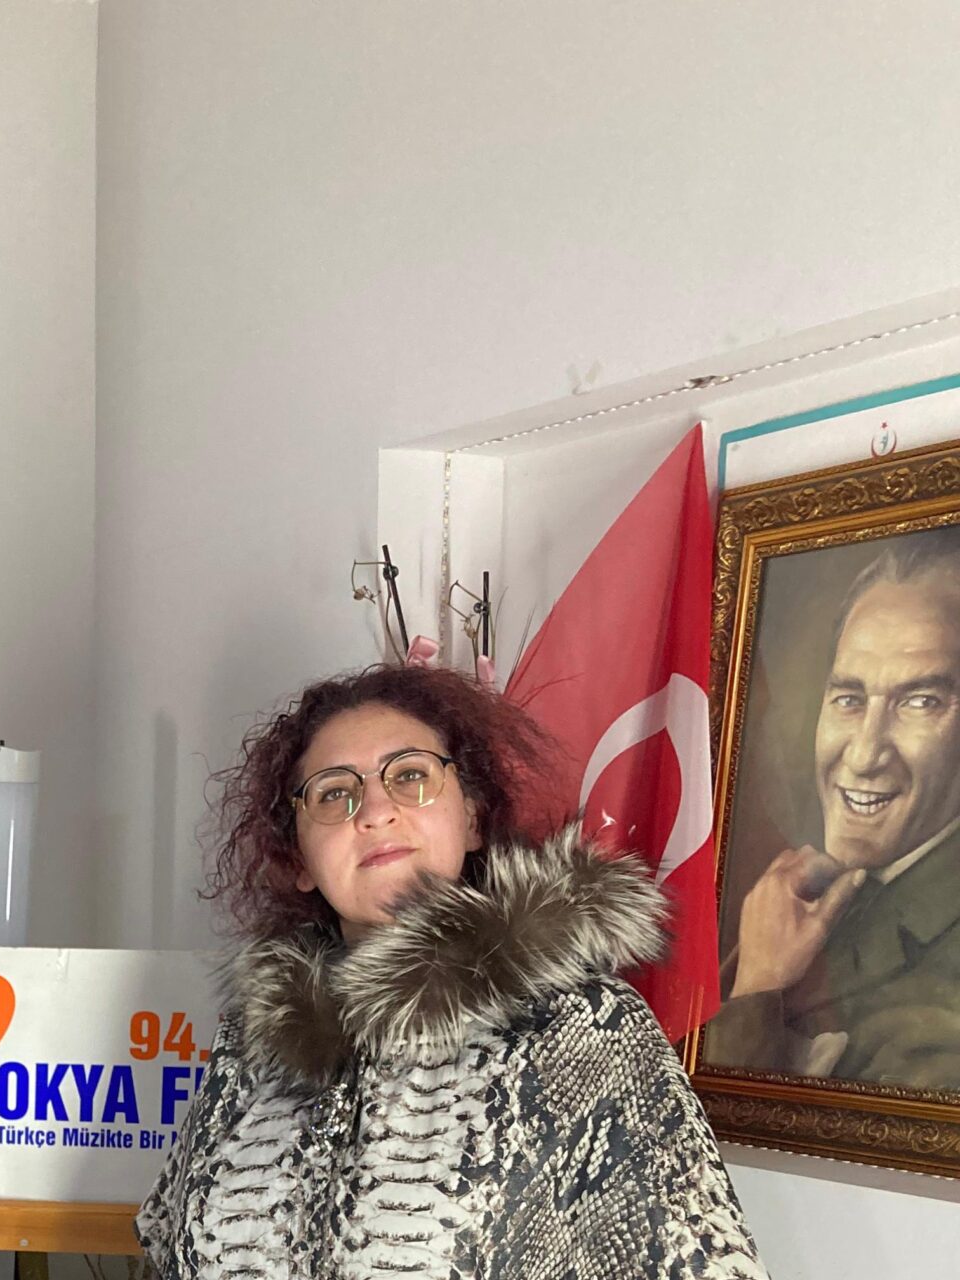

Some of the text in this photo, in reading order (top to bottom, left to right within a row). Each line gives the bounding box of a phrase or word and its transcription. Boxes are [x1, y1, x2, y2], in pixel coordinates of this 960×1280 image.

[129, 1011, 224, 1061] 94.
[161, 1066, 205, 1125] F
[63, 1127, 133, 1149] Müzikte
[140, 1130, 165, 1149] Bir
